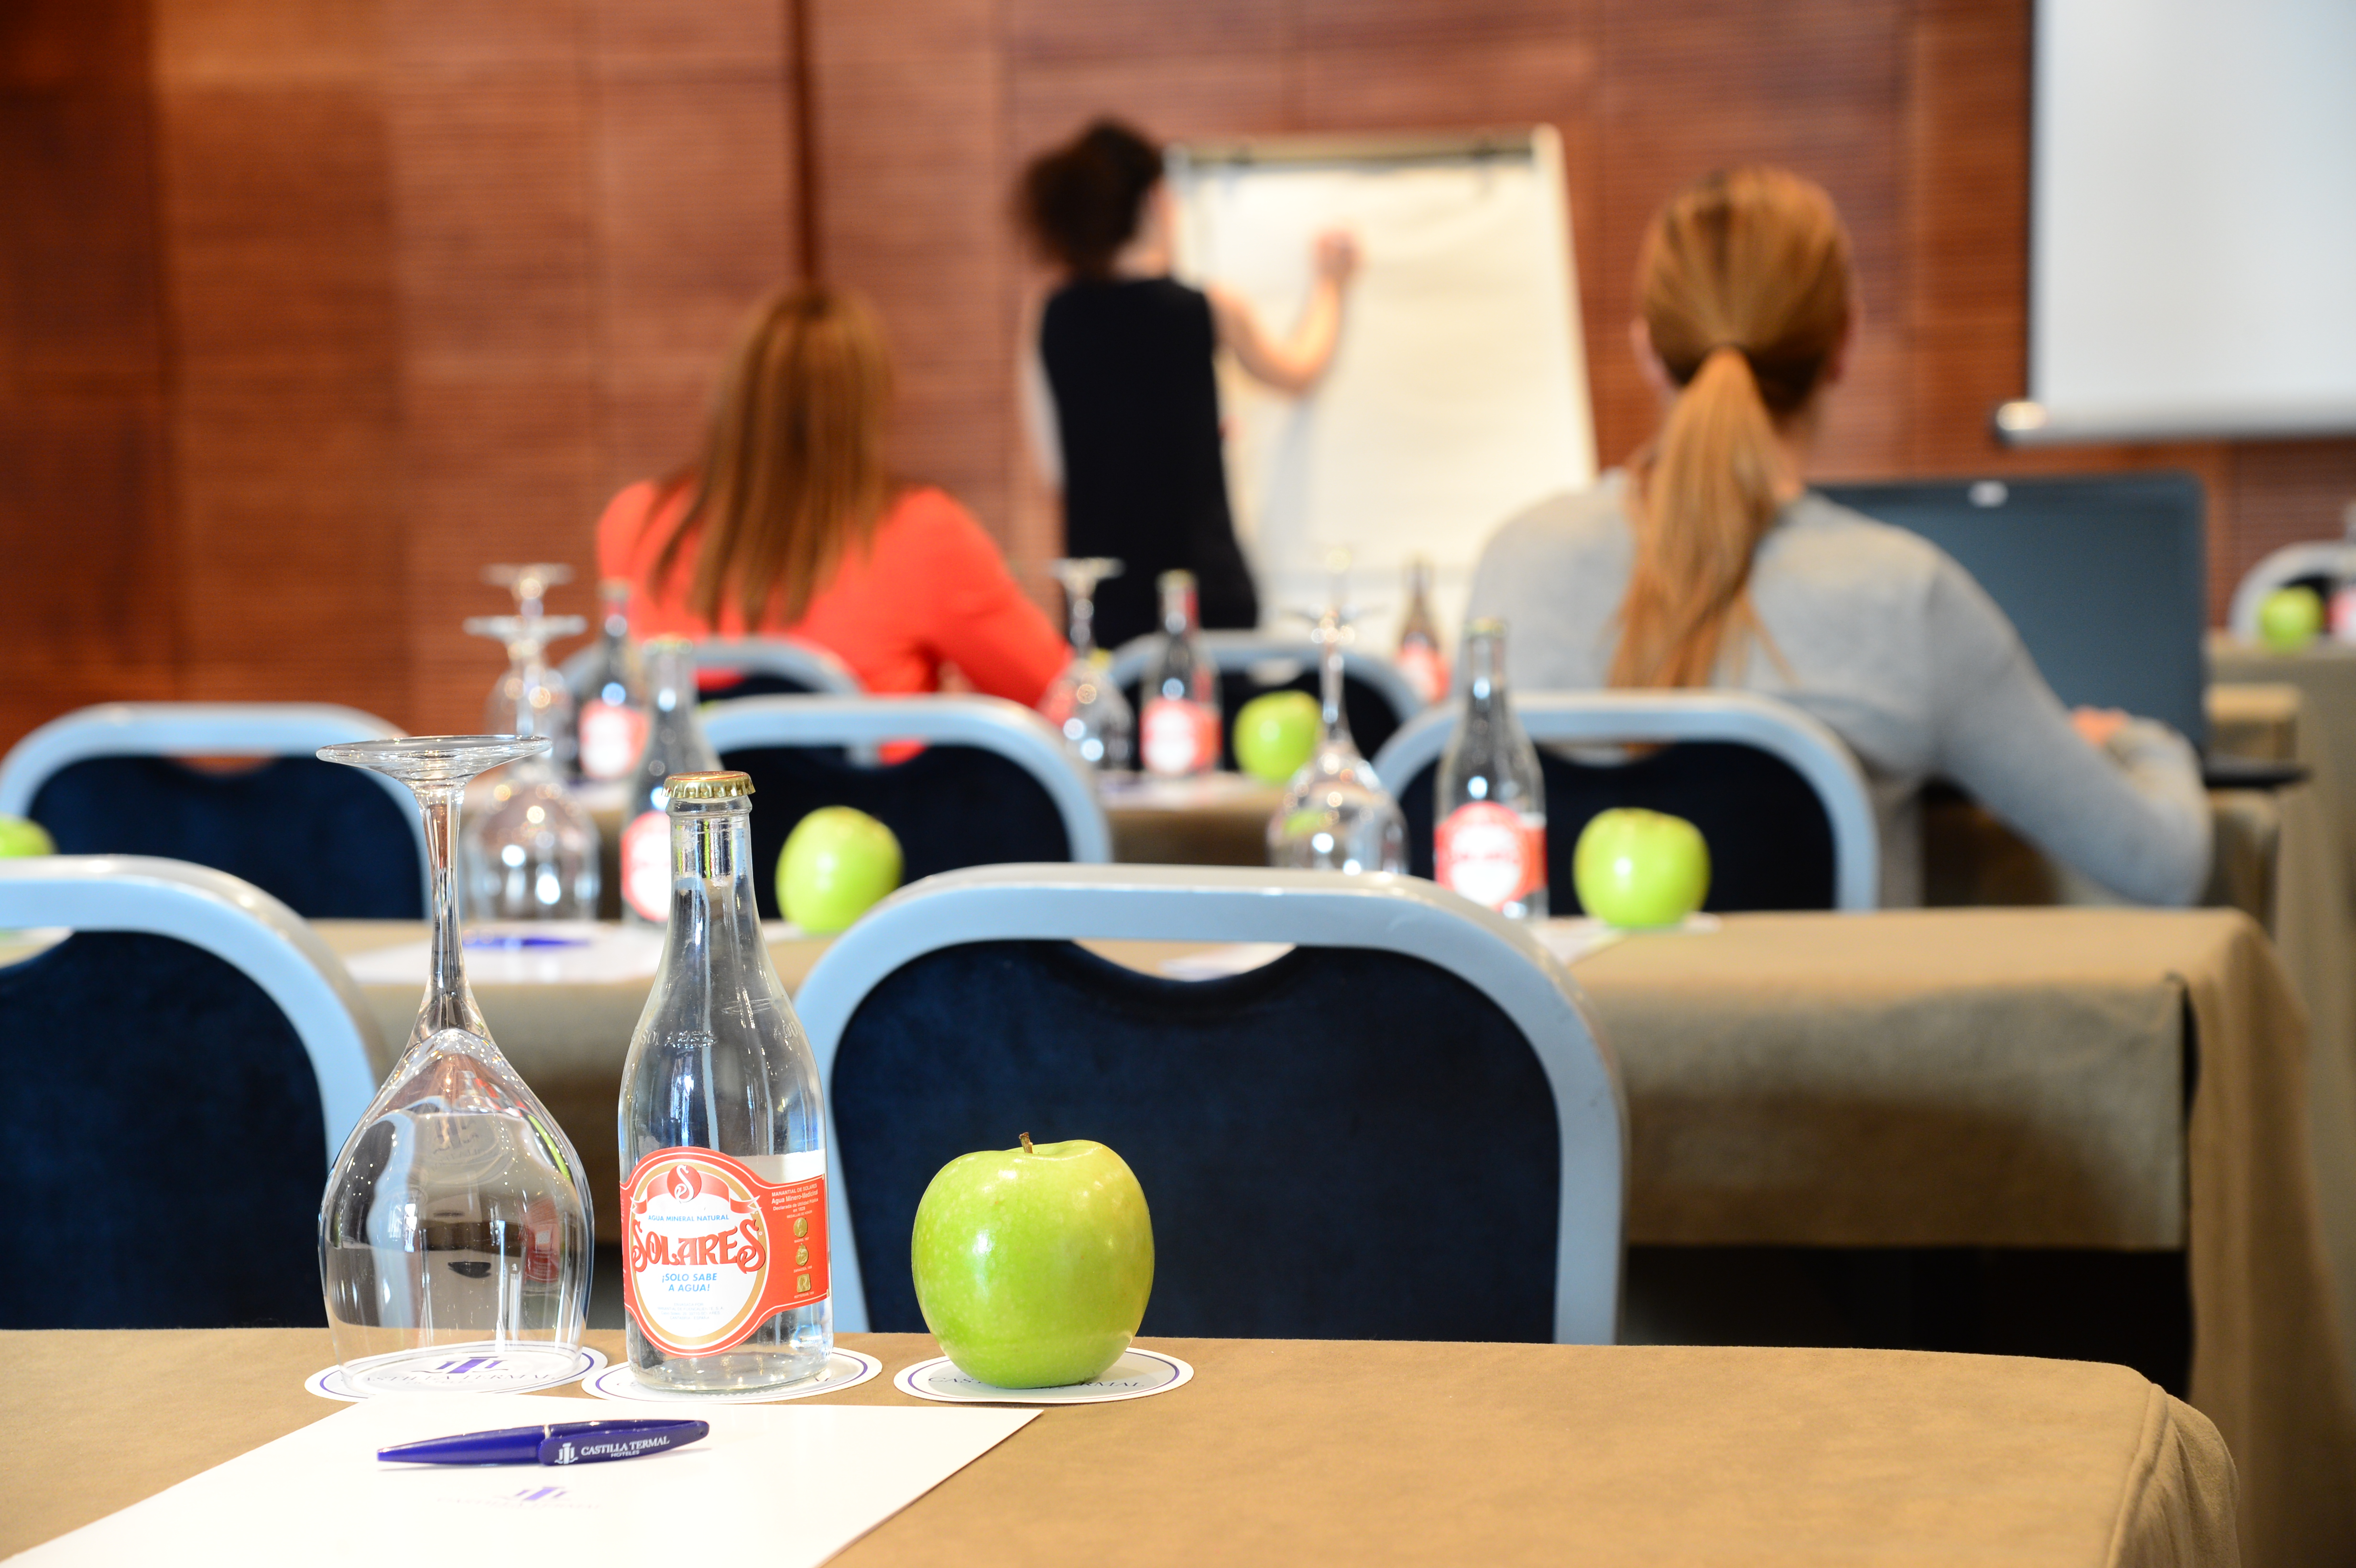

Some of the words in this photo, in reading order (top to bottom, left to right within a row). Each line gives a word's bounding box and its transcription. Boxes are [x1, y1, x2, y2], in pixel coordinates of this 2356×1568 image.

[772, 1188, 796, 1197] MANANTIAL
[786, 1189, 818, 1202] Minero-Medicinal
[631, 1219, 766, 1274] SOLARES
[662, 1273, 689, 1283] ¡SOLO
[693, 1273, 717, 1281] SABE
[678, 1284, 710, 1292] AGUA!
[580, 1443, 628, 1456] CASTILLA
[629, 1436, 670, 1450] TERMAL
[611, 1449, 640, 1458] HOTELES
